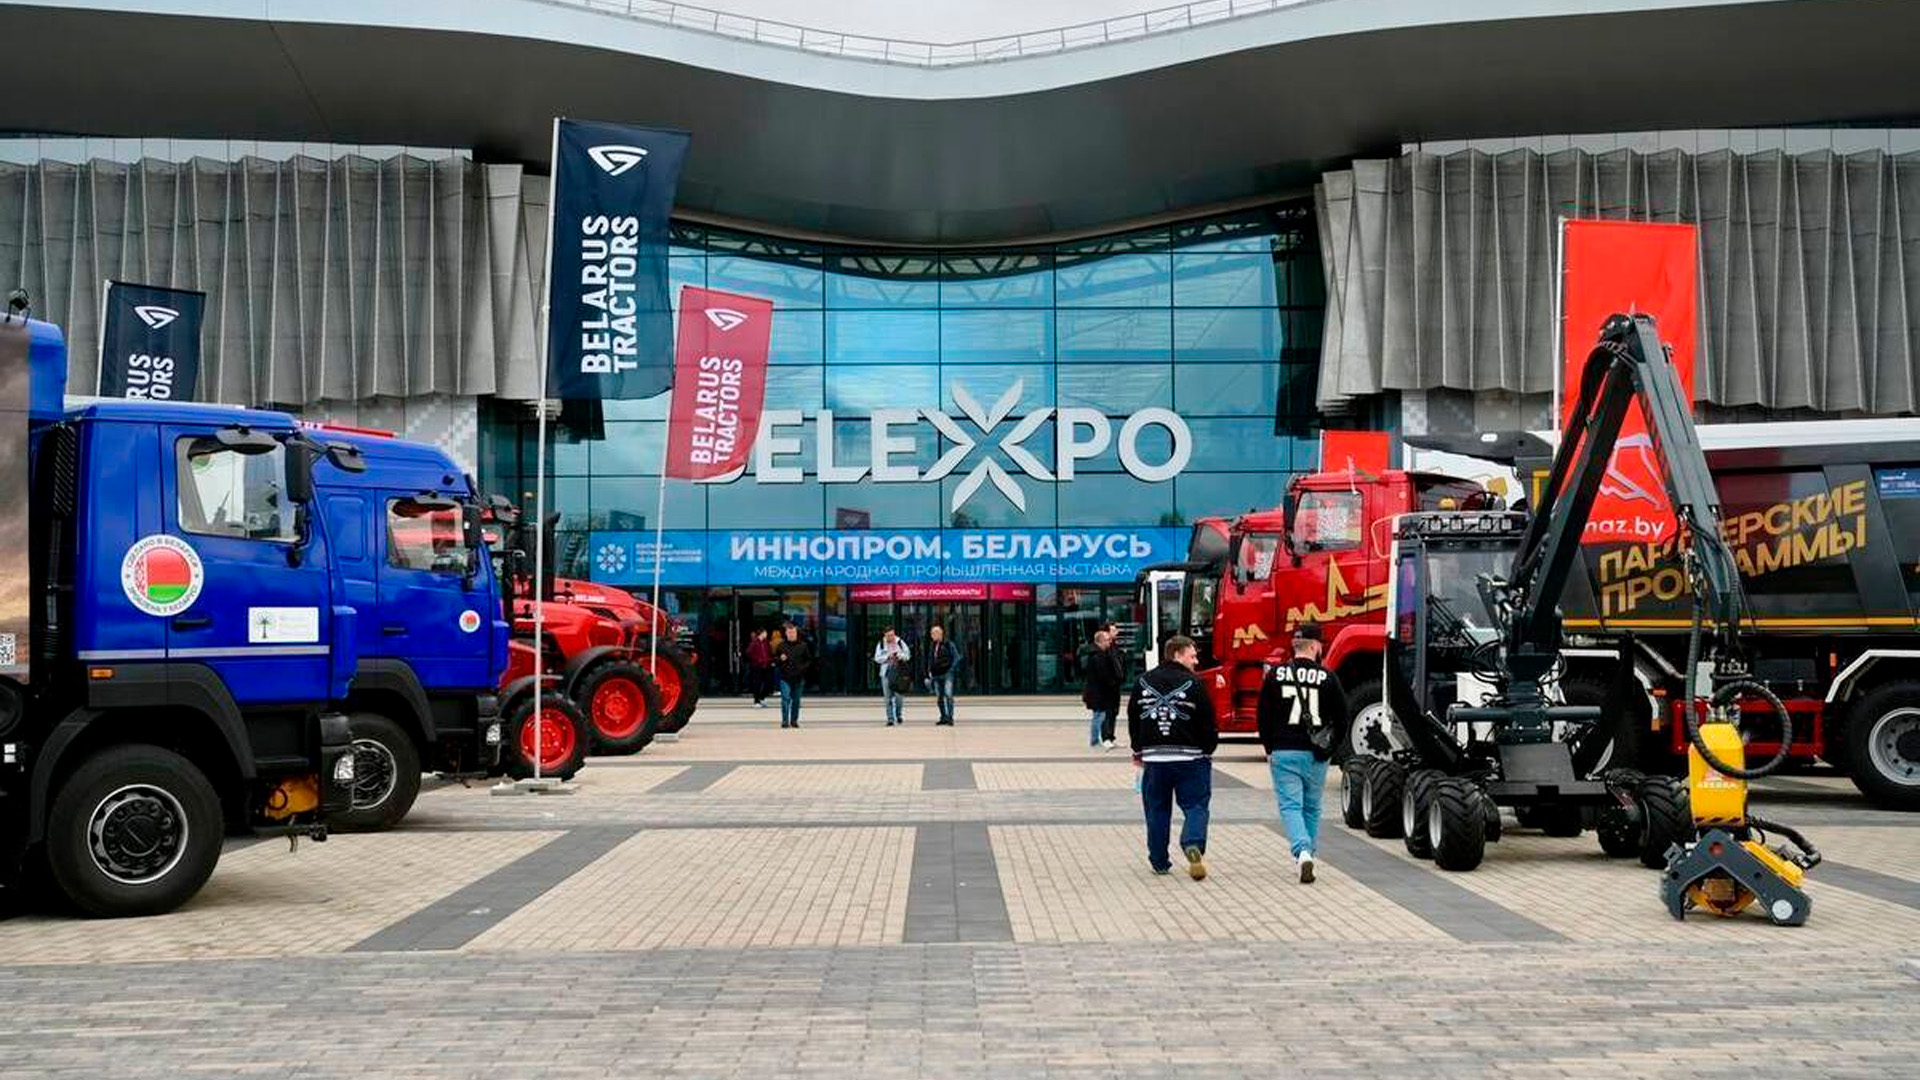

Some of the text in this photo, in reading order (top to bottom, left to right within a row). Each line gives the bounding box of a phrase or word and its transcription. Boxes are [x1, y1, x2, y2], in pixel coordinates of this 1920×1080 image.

[581, 215, 609, 374] BELARUS
[611, 216, 639, 374] TRACTORS
[691, 356, 721, 464] BELARUS
[693, 379, 1192, 513] ELEXPO
[713, 359, 743, 464] TRACTORS
[731, 535, 1152, 561] ИННОПРОМ. БЕЛАРУСЬ
[754, 563, 1132, 580] МЕЖДУНАРОДНАЯ ПРОМЫШЛЕННАЯ ВЫСТАВКА
[1602, 516, 1868, 617] ПРОАММЫ
[1276, 666, 1328, 685] SNOOP
[1281, 685, 1322, 726] 71
